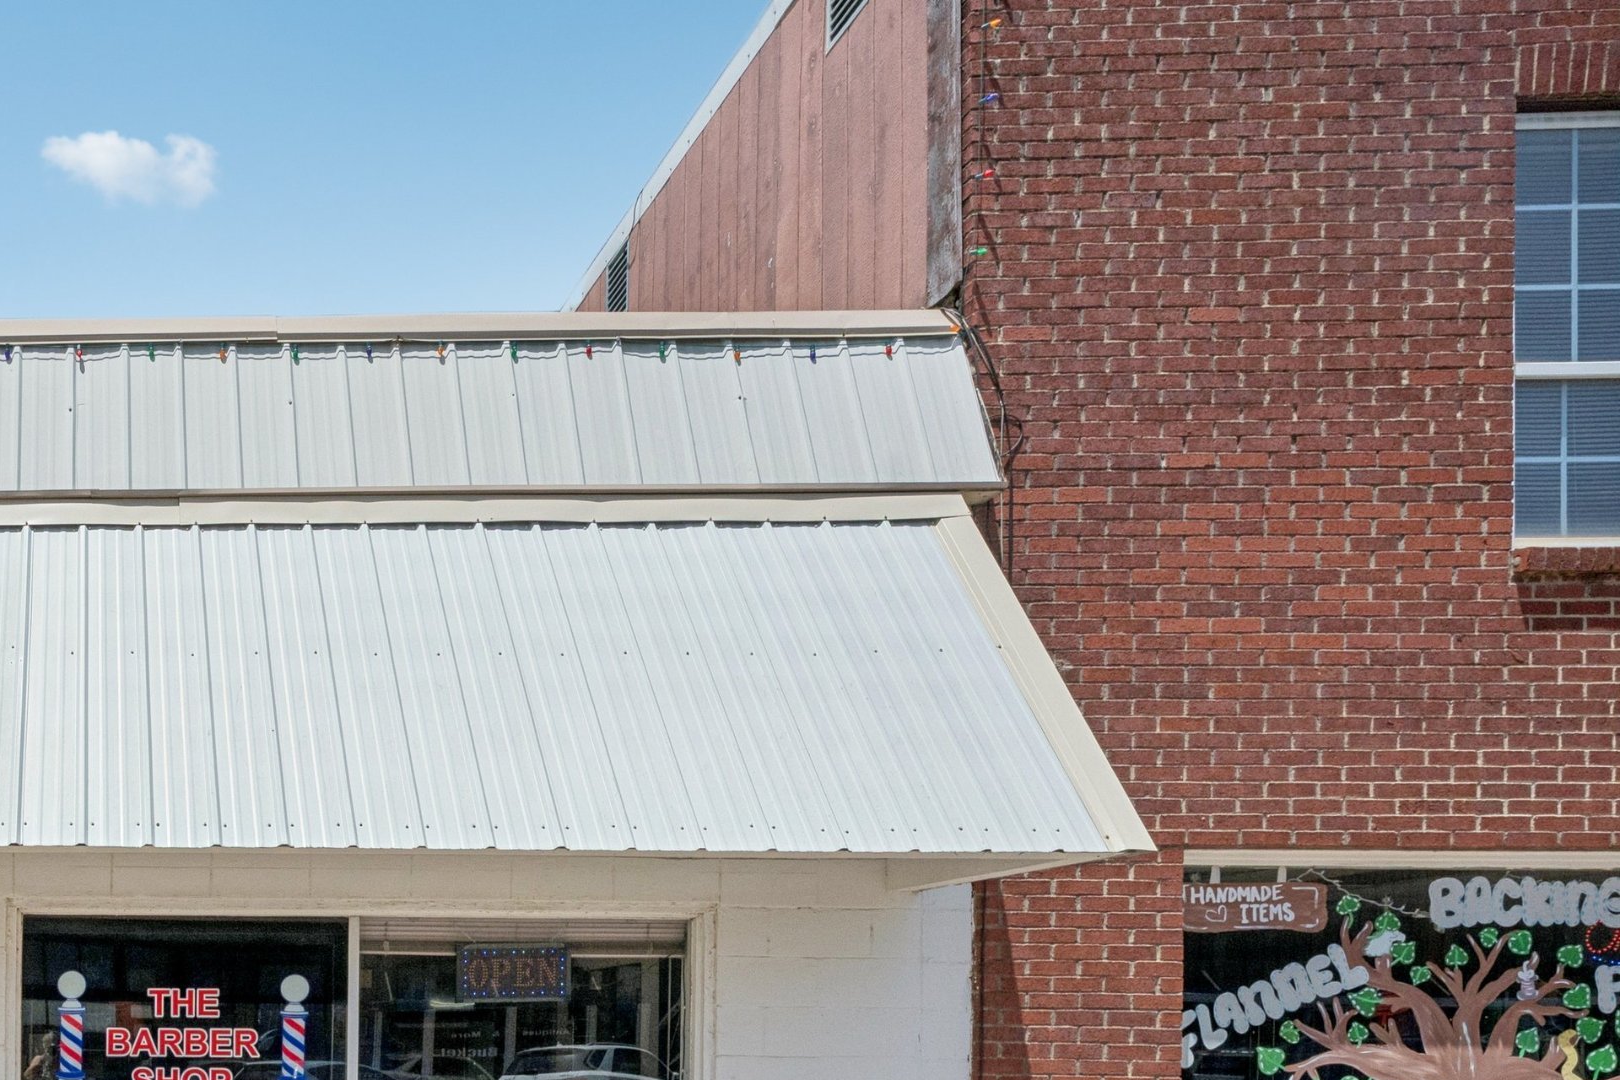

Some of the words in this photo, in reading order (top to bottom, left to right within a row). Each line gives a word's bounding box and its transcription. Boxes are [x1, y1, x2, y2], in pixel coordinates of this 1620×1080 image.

[1191, 885, 1283, 904] HANDMADE
[1240, 903, 1295, 923] ITEMS
[469, 958, 558, 987] OPEN
[147, 988, 220, 1018] THE
[106, 1027, 260, 1058] BARBER
